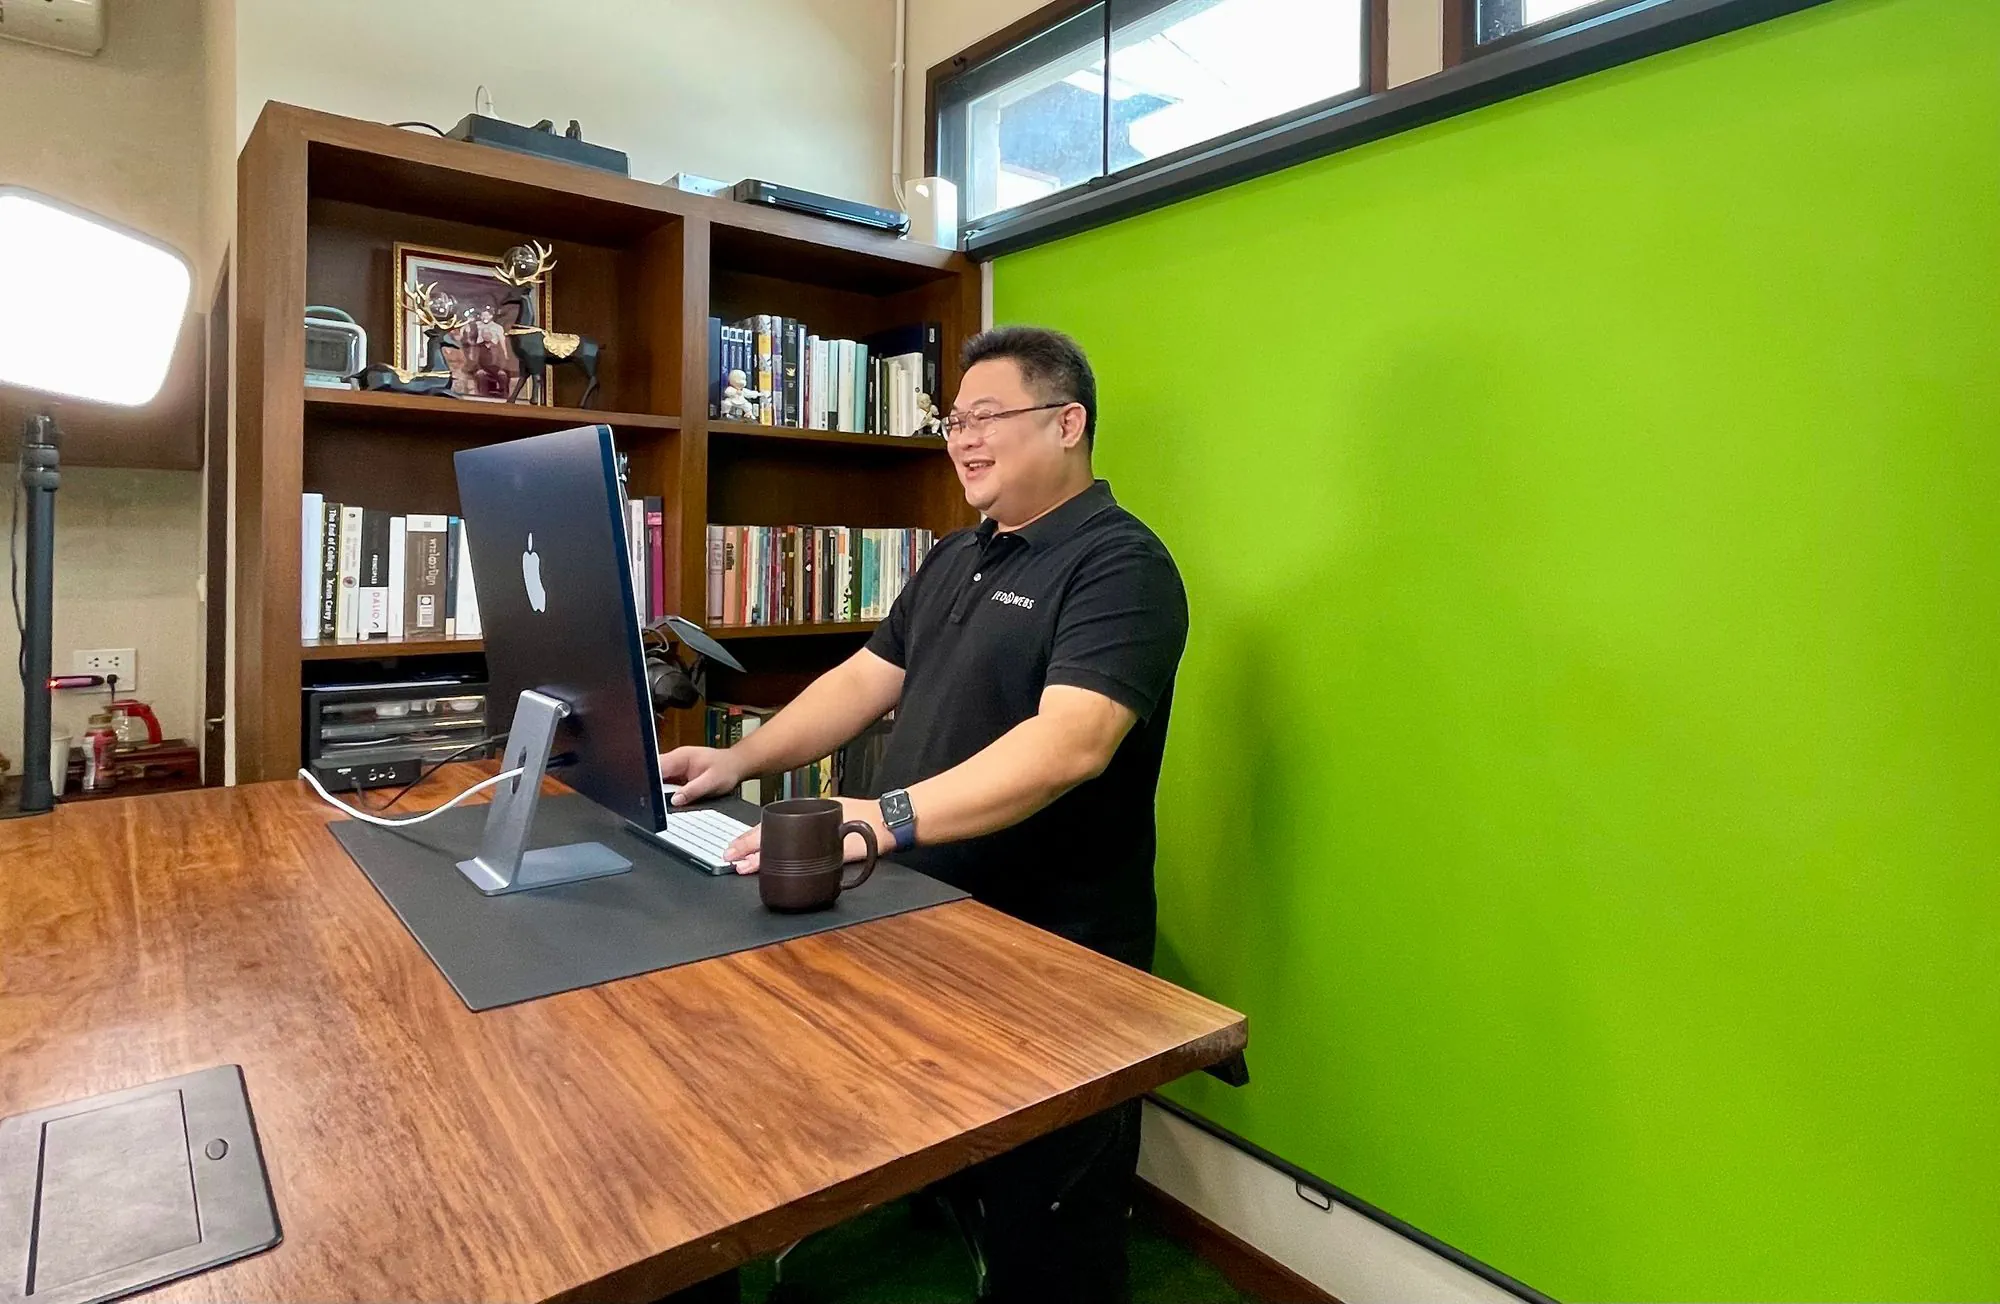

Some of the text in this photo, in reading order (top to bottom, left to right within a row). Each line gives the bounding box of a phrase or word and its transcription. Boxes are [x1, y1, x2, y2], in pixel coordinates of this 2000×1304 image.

[325, 509, 337, 572] The End of College
[371, 592, 381, 620] DALIO
